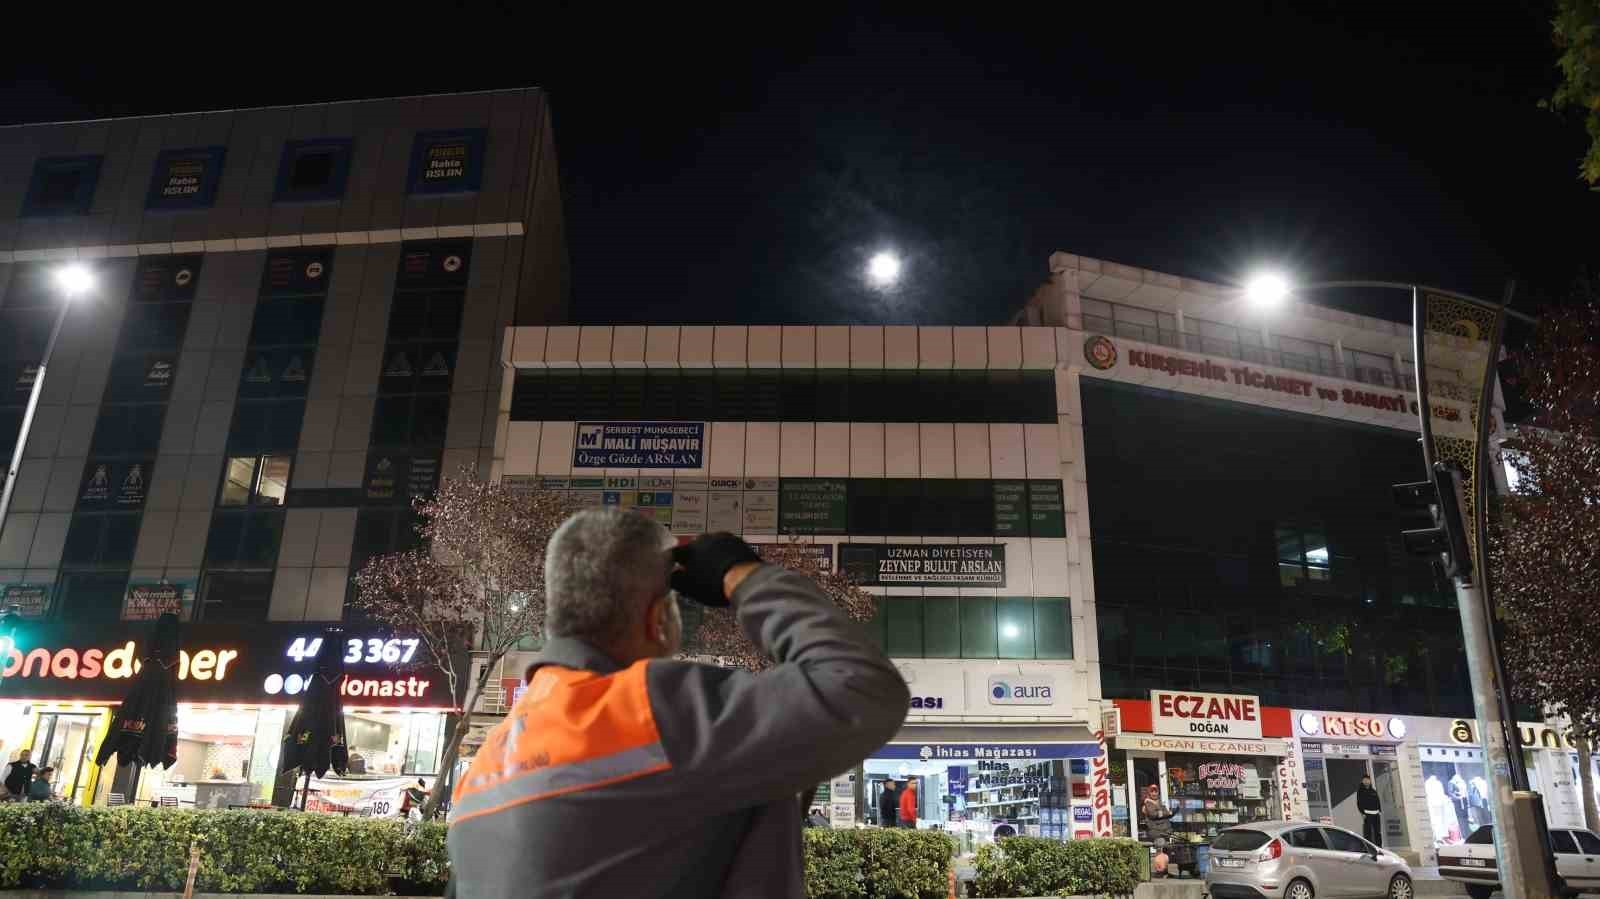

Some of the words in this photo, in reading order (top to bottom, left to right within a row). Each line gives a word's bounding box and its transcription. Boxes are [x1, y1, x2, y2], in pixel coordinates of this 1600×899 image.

[1129, 351, 1228, 382] KIRŞEHİR
[1230, 367, 1312, 395] TİCARET
[1317, 388, 1337, 401] ve
[1342, 388, 1407, 413] SANAYİ
[604, 434, 636, 449] MALİ
[640, 435, 699, 452] MÜŞAVİR
[578, 452, 606, 464] Özge
[608, 453, 642, 463] Gözde
[644, 454, 697, 464] ARSLAN
[887, 548, 928, 558] UZMAN
[932, 547, 992, 558] DİYETİSYEN
[880, 560, 920, 573] ZEYNEP
[924, 560, 957, 573] BULUT
[960, 560, 1001, 573] ARSLAN
[1014, 684, 1050, 698] aura
[1159, 694, 1256, 721] ECZANE
[1190, 720, 1228, 734] DOĞAN
[1322, 716, 1385, 737] KTSO
[936, 746, 969, 757] İhlas
[975, 747, 1037, 758] Mağazası
[373, 800, 390, 815] 180
[1075, 808, 1092, 816] REGAL
